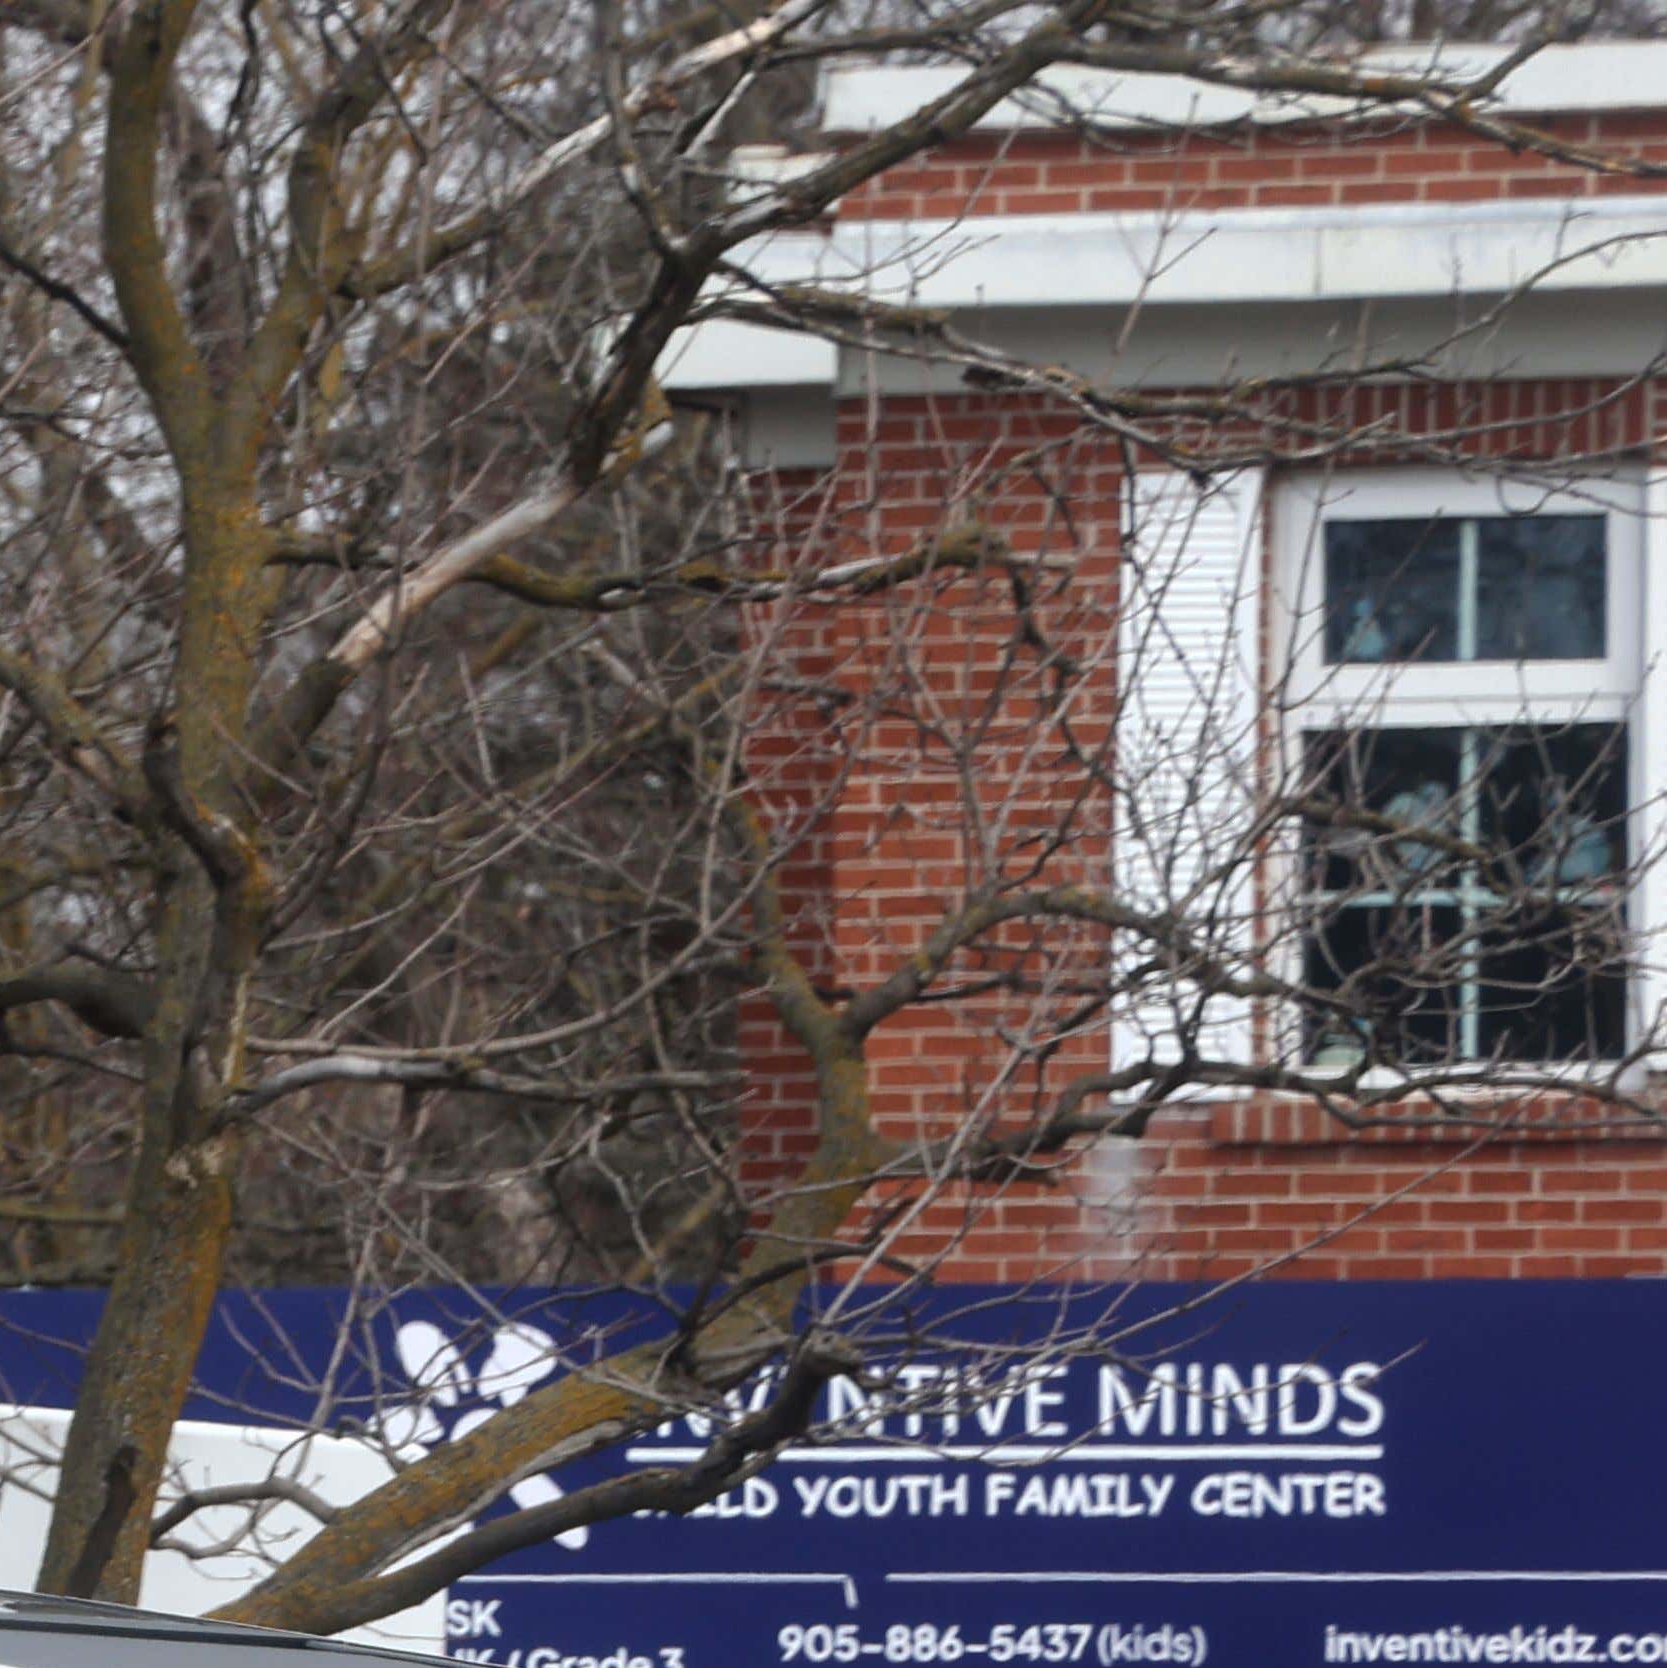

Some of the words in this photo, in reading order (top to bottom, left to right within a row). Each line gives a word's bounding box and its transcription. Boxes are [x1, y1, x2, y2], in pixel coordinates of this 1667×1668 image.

[1098, 1361, 1386, 1437] MINDS
[793, 1473, 970, 1518] YOUTH
[985, 1471, 1175, 1518] FAMILY
[1190, 1470, 1387, 1519] CENTER
[777, 1622, 1092, 1663] 905-886-5437
[1096, 1623, 1207, 1668] (kids)
